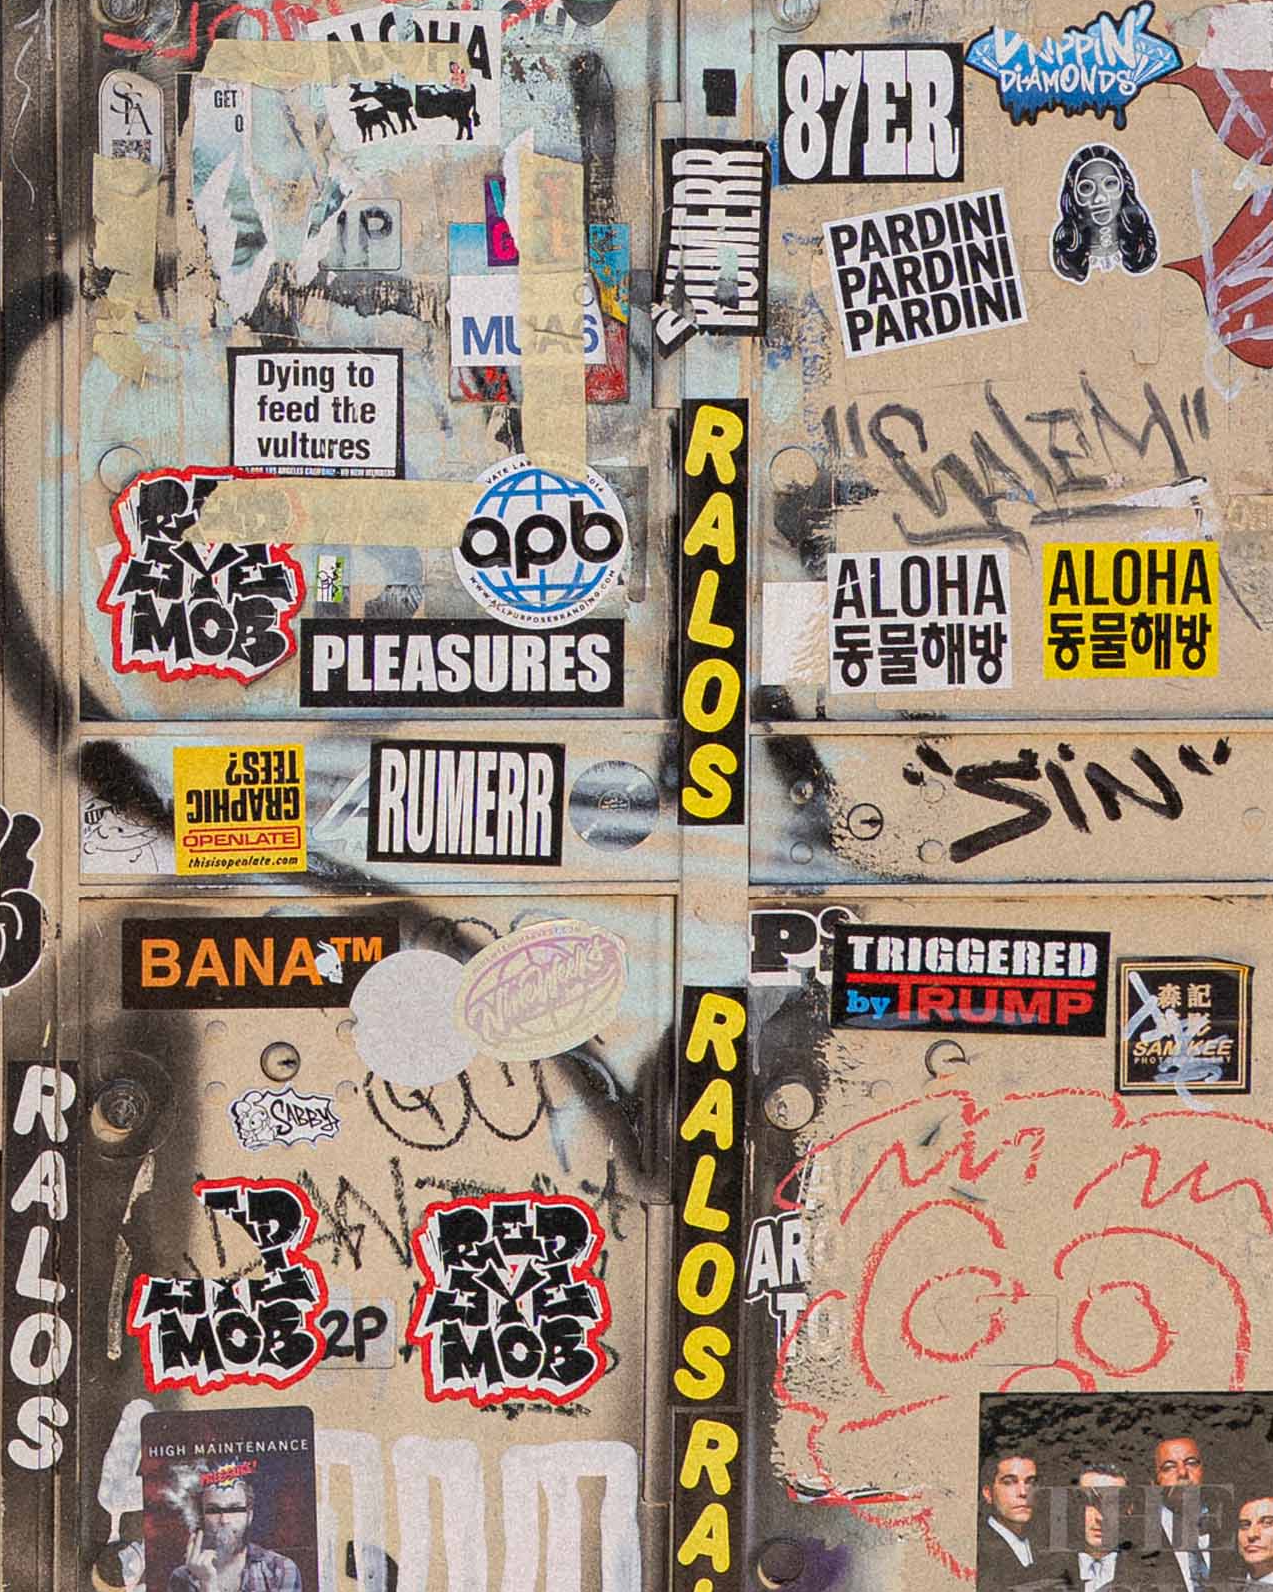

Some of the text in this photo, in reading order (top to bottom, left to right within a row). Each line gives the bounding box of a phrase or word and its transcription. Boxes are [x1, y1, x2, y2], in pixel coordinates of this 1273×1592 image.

[783, 48, 960, 180] 87ER
[831, 194, 1005, 265] PARDINI
[838, 233, 1013, 307] PARDINI
[846, 278, 1023, 352] PARDINI
[257, 359, 374, 393] Dying to
[257, 395, 376, 424] feed the
[257, 431, 371, 460] vultures
[459, 500, 624, 579] apb
[833, 553, 1006, 619] ALOHA
[1049, 546, 1211, 607] ALOHA
[132, 593, 289, 667] MOB
[682, 405, 744, 819] RALOS
[1047, 611, 1213, 671] 동물해방
[312, 633, 611, 694] PLEASURES
[833, 622, 1007, 687] 동물해방
[225, 750, 300, 785] TEES?
[186, 786, 300, 823] GRAPHIC
[378, 748, 553, 856] RUMERR
[182, 832, 296, 848] OPENLATE
[188, 857, 298, 869] thisisopenlate.com
[848, 936, 1097, 977] TRIGGERED
[847, 981, 1094, 1025] by TRUMP
[270, 1099, 340, 1135] SABBY
[673, 993, 746, 1400] RALOS
[7, 1064, 77, 1471] RALOS
[437, 1200, 590, 1271] RED
[162, 1300, 317, 1374] MOB
[443, 1318, 599, 1387] MOB
[149, 1439, 308, 1457] HIGH MAINTENANCE
[1032, 1484, 1236, 1553] THE
